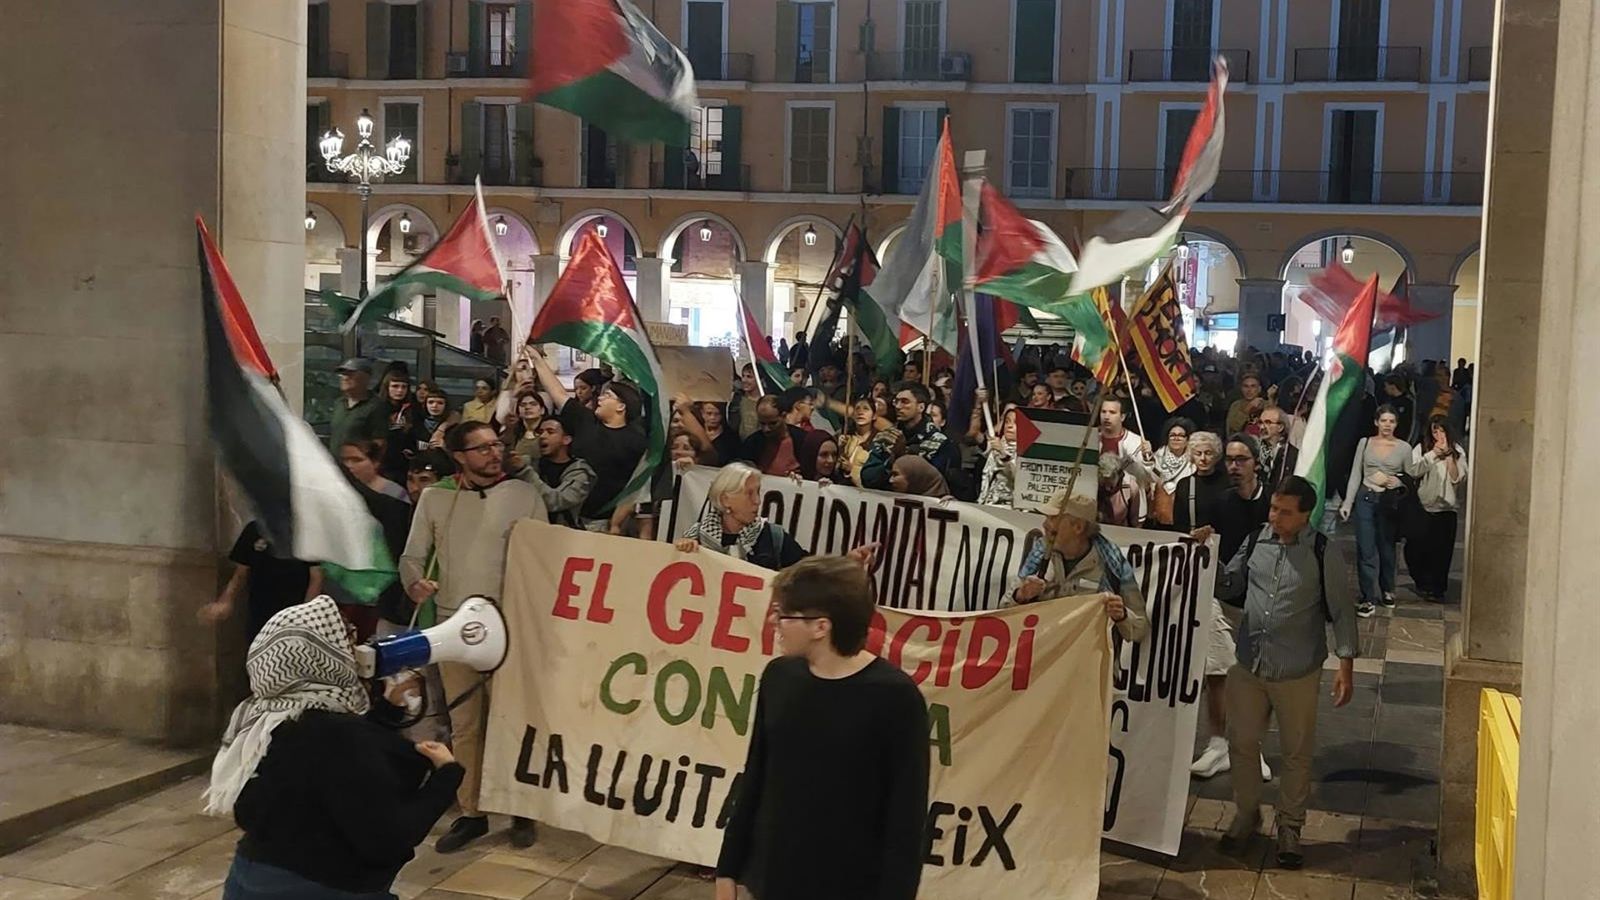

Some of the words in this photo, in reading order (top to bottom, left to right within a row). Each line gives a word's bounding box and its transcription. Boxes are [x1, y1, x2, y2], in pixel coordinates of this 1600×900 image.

[1030, 472, 1042, 482] TO
[552, 557, 614, 624] EL
[515, 724, 569, 794] LA
